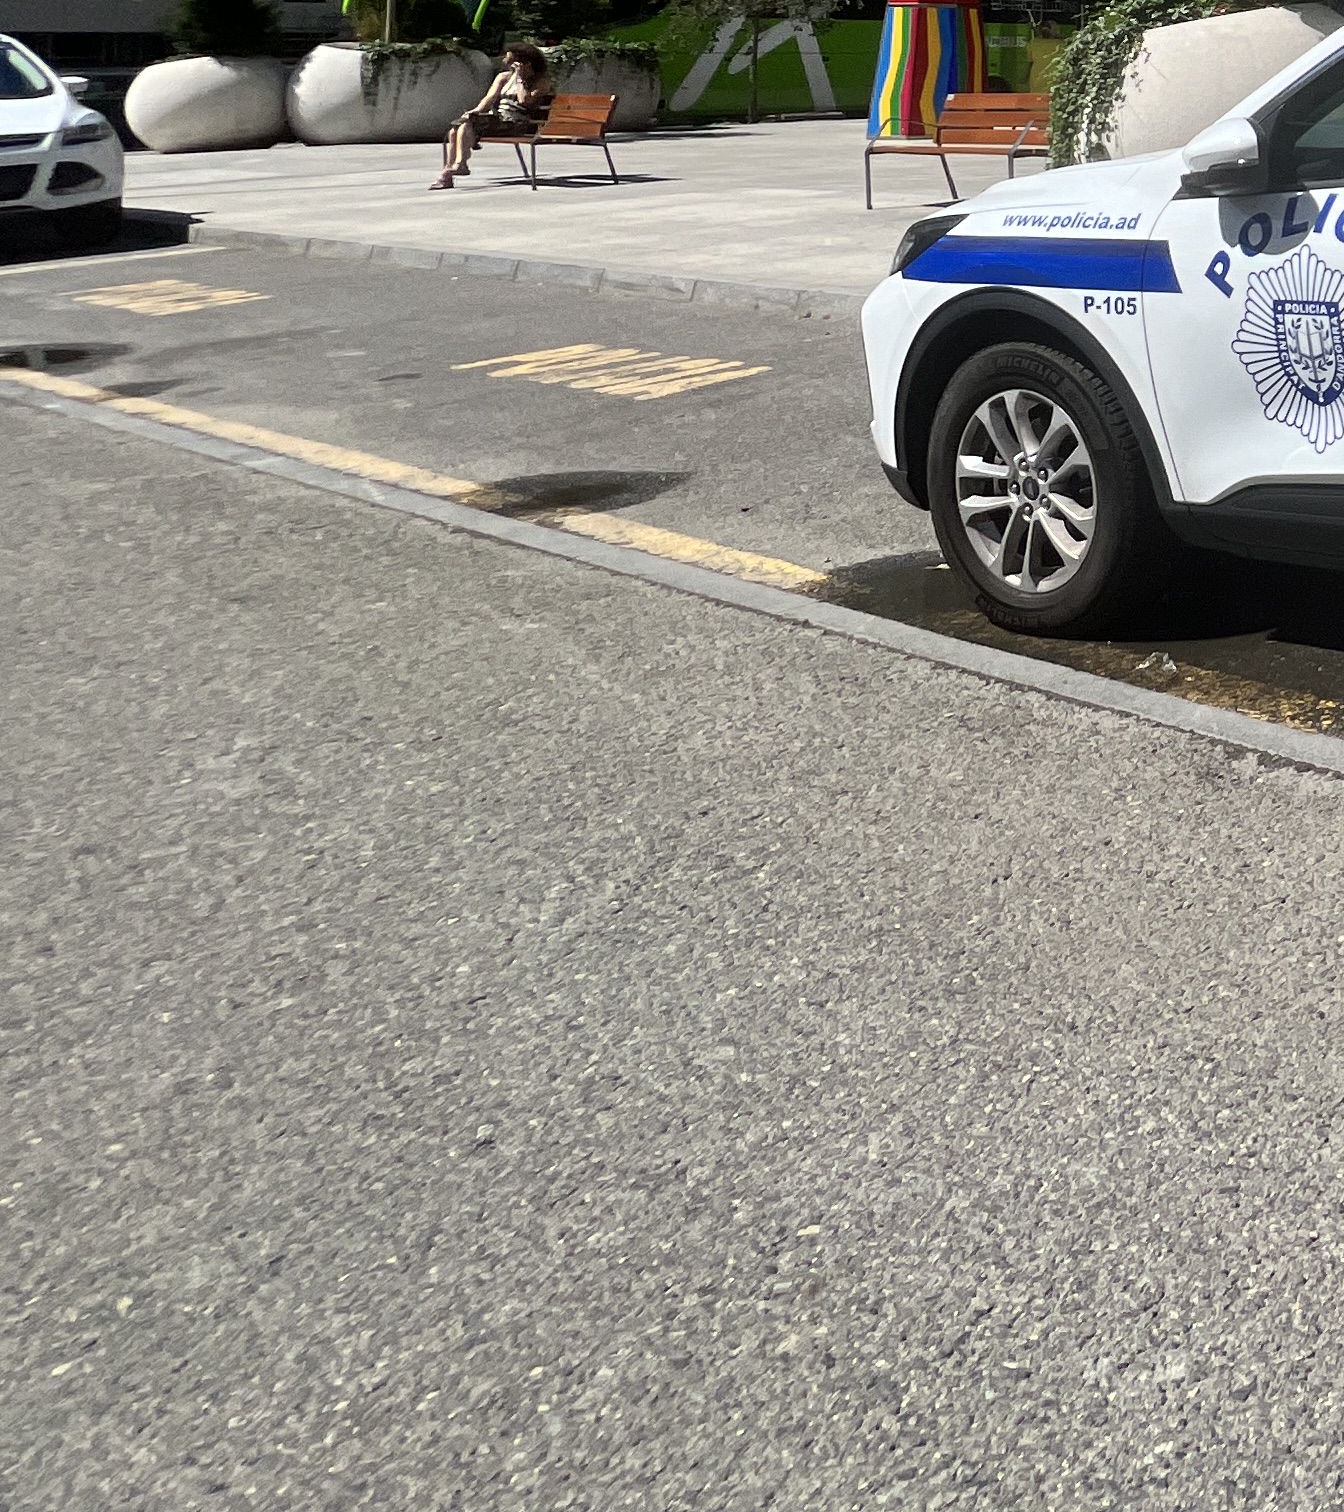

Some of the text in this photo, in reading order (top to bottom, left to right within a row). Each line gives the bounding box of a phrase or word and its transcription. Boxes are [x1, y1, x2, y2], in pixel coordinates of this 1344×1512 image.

[1001, 212, 1142, 232] www.policia.ad
[1083, 296, 1138, 315] P-105
[1284, 303, 1328, 314] POLICIA
